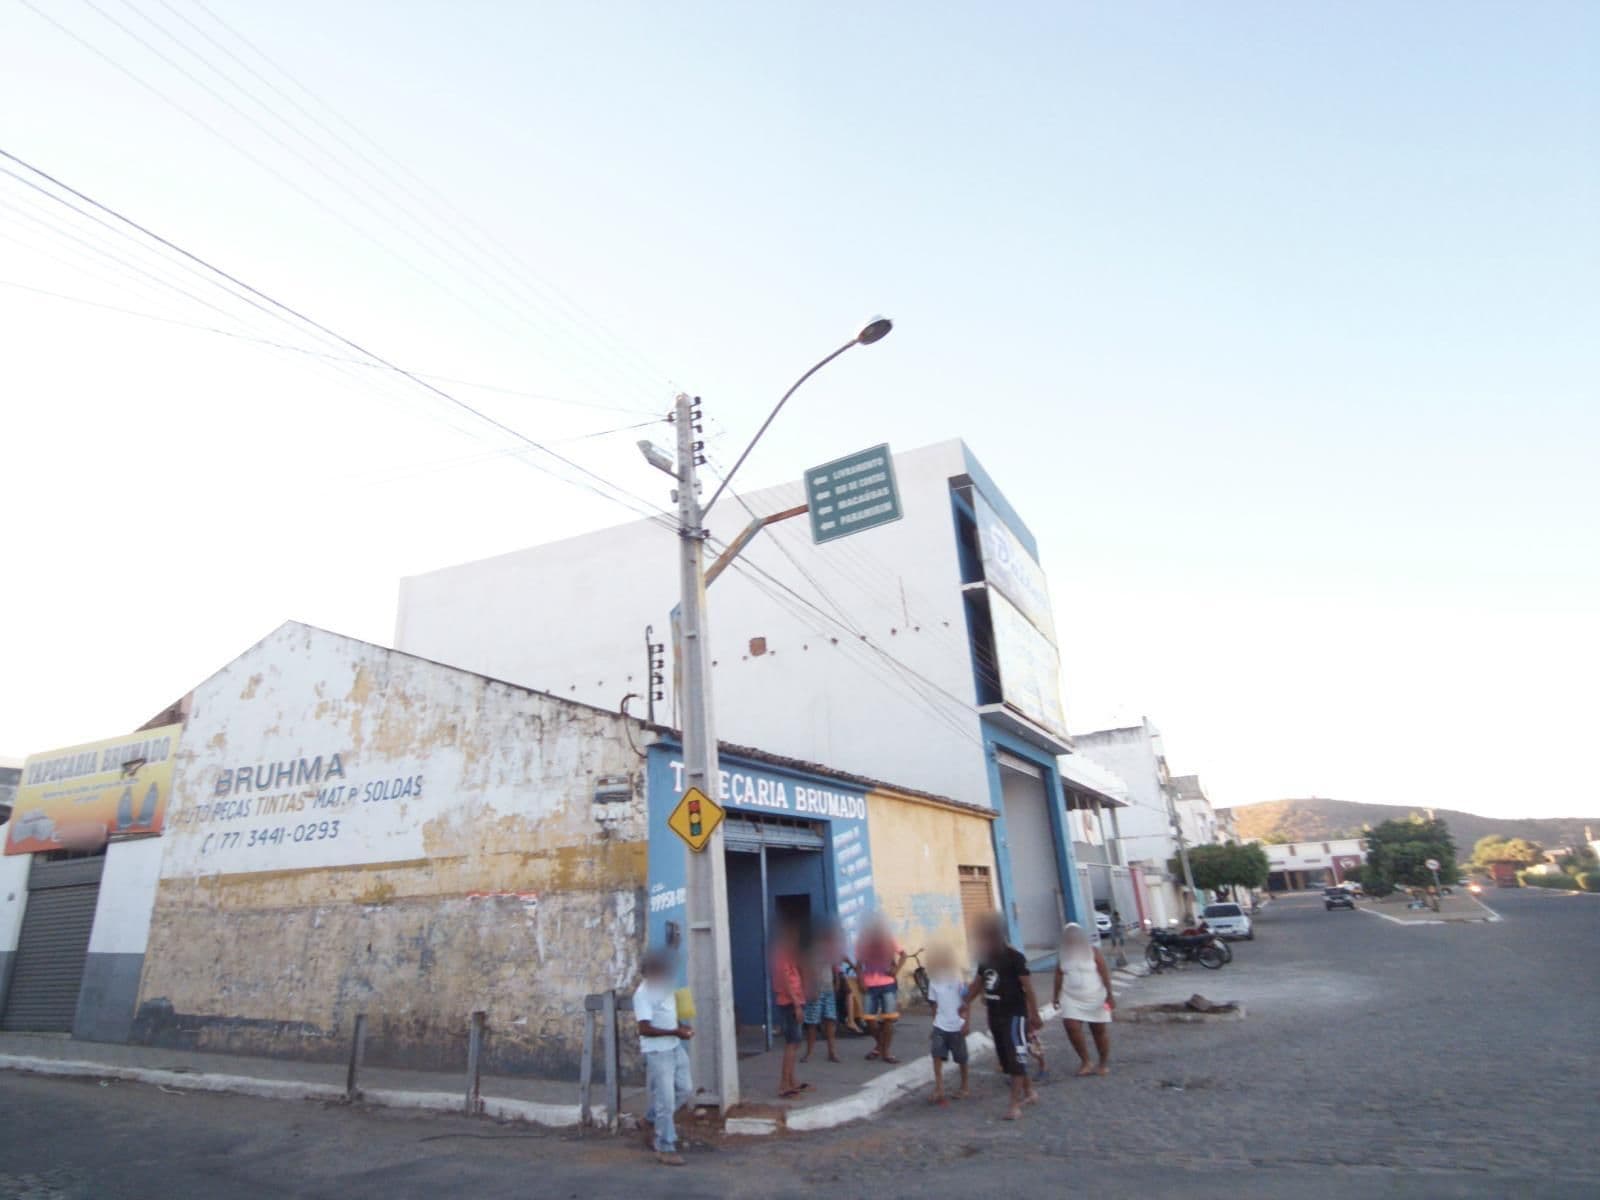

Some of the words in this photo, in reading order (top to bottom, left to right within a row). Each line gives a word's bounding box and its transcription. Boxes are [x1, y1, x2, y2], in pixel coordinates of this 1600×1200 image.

[214, 754, 345, 797] BRUHMA
[362, 774, 424, 804] SOLDAS
[670, 760, 788, 808] TEÇARIA
[795, 787, 865, 820] BRUMADO
[246, 819, 341, 848] 3441-0293
